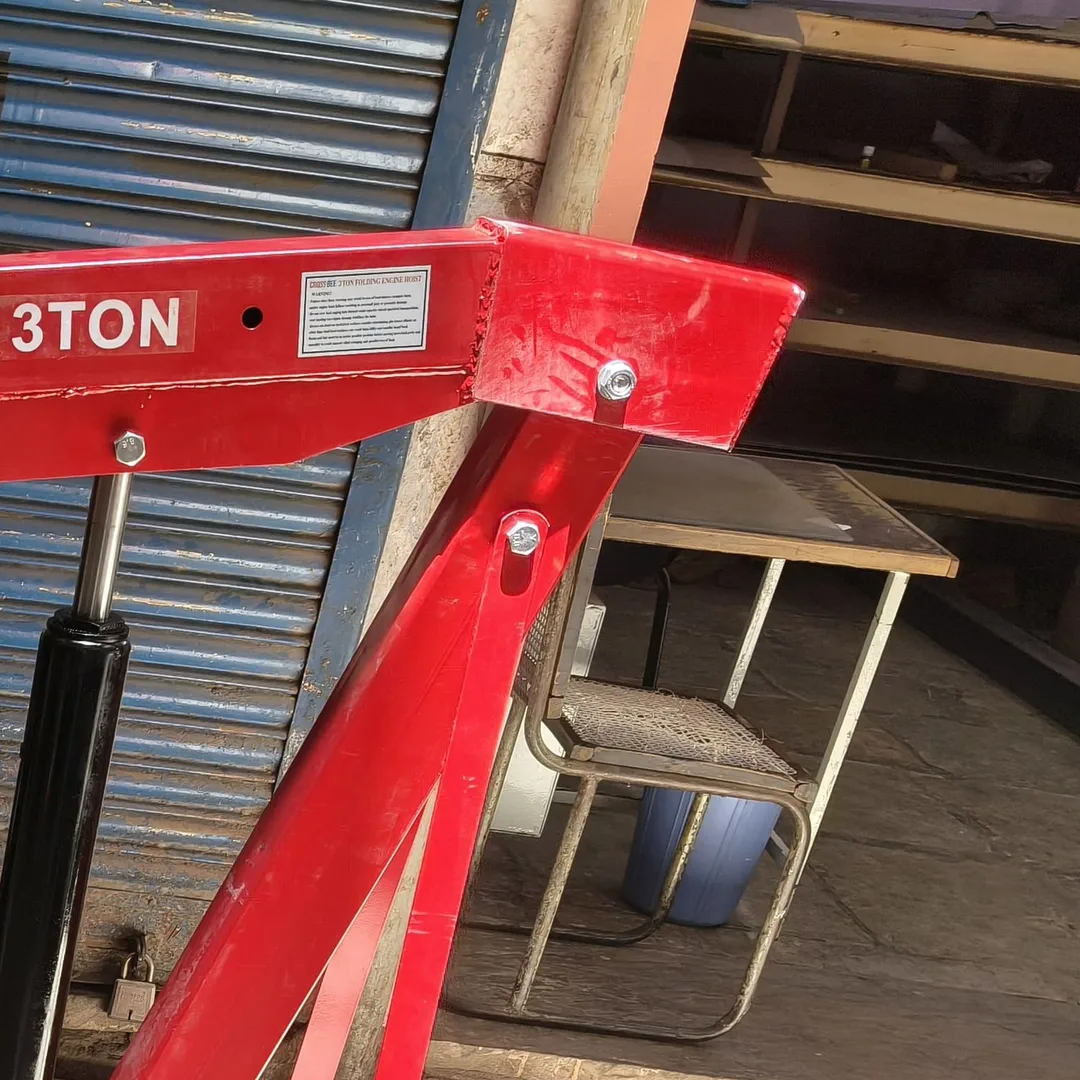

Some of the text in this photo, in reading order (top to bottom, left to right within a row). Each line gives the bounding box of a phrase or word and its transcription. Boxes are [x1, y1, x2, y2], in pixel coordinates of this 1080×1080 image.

[355, 278, 381, 287] FOLDING
[381, 276, 404, 285] ENGINE
[404, 275, 422, 283] HOIST
[12, 298, 179, 352] 3TON
